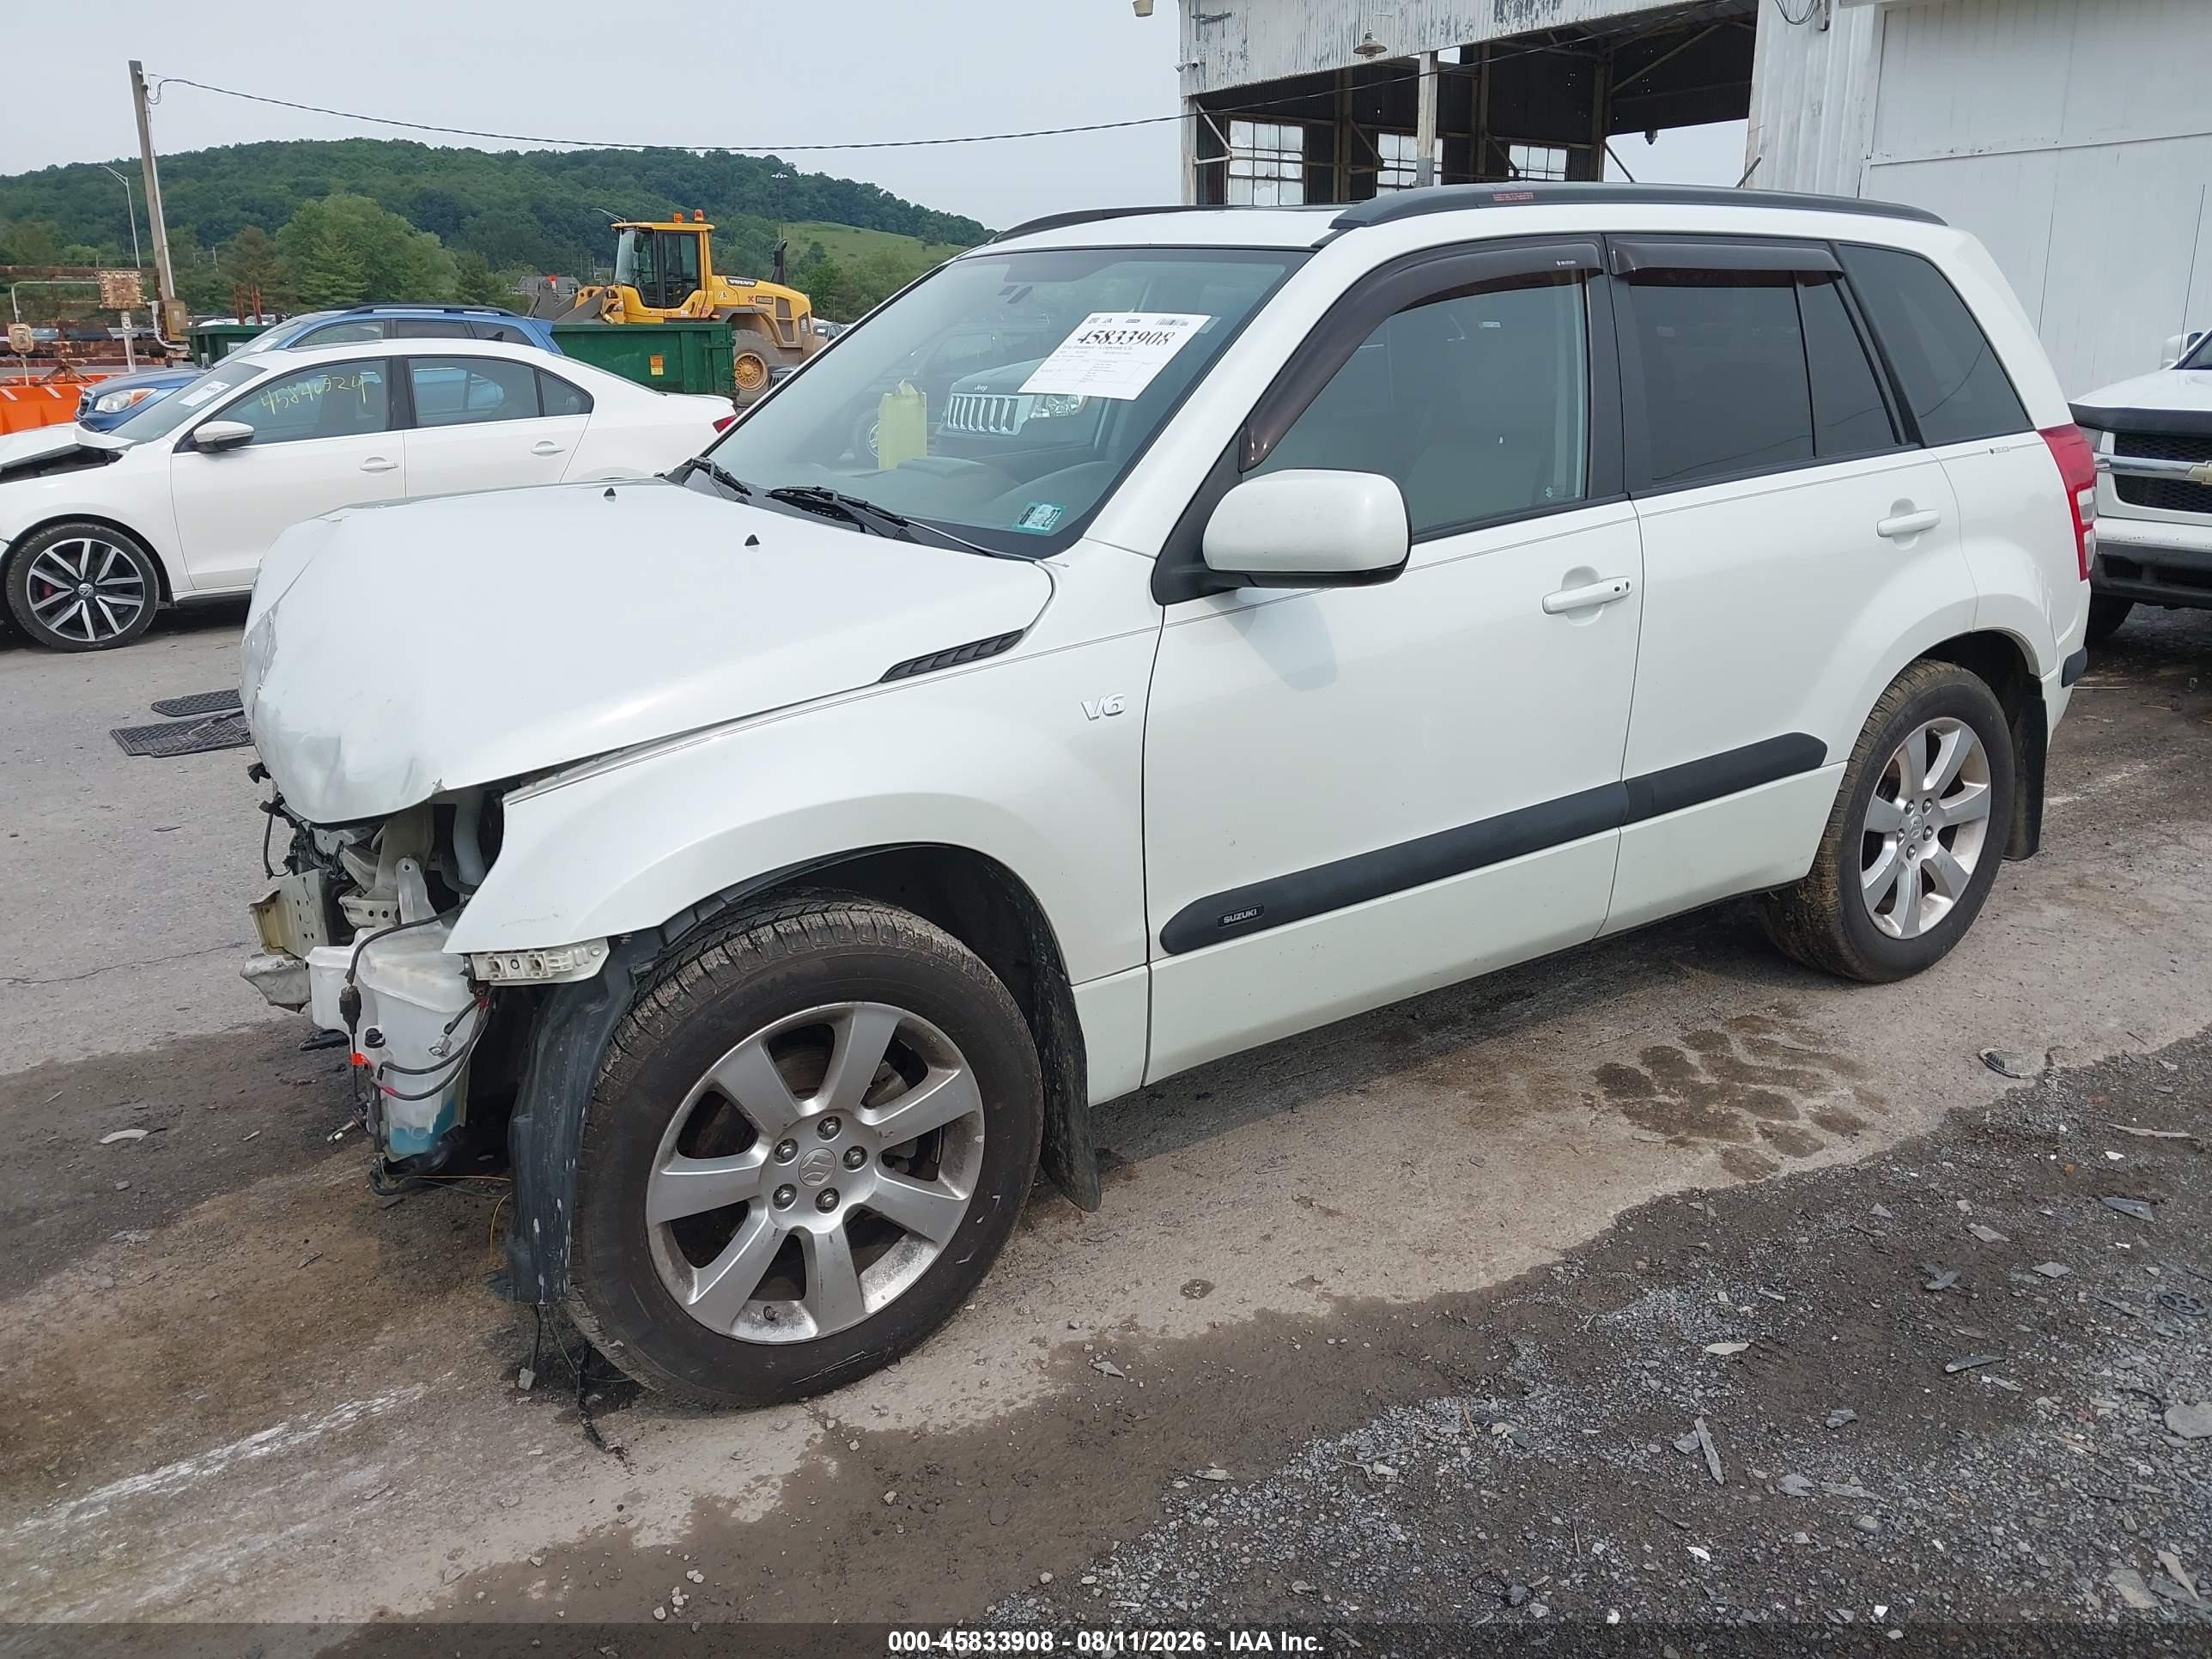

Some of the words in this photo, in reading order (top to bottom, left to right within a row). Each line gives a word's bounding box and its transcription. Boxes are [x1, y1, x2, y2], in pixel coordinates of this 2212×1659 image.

[1077, 330, 1176, 345] 45833908
[1080, 692, 1126, 721] V6
[1224, 908, 1257, 923] SUZUKI
